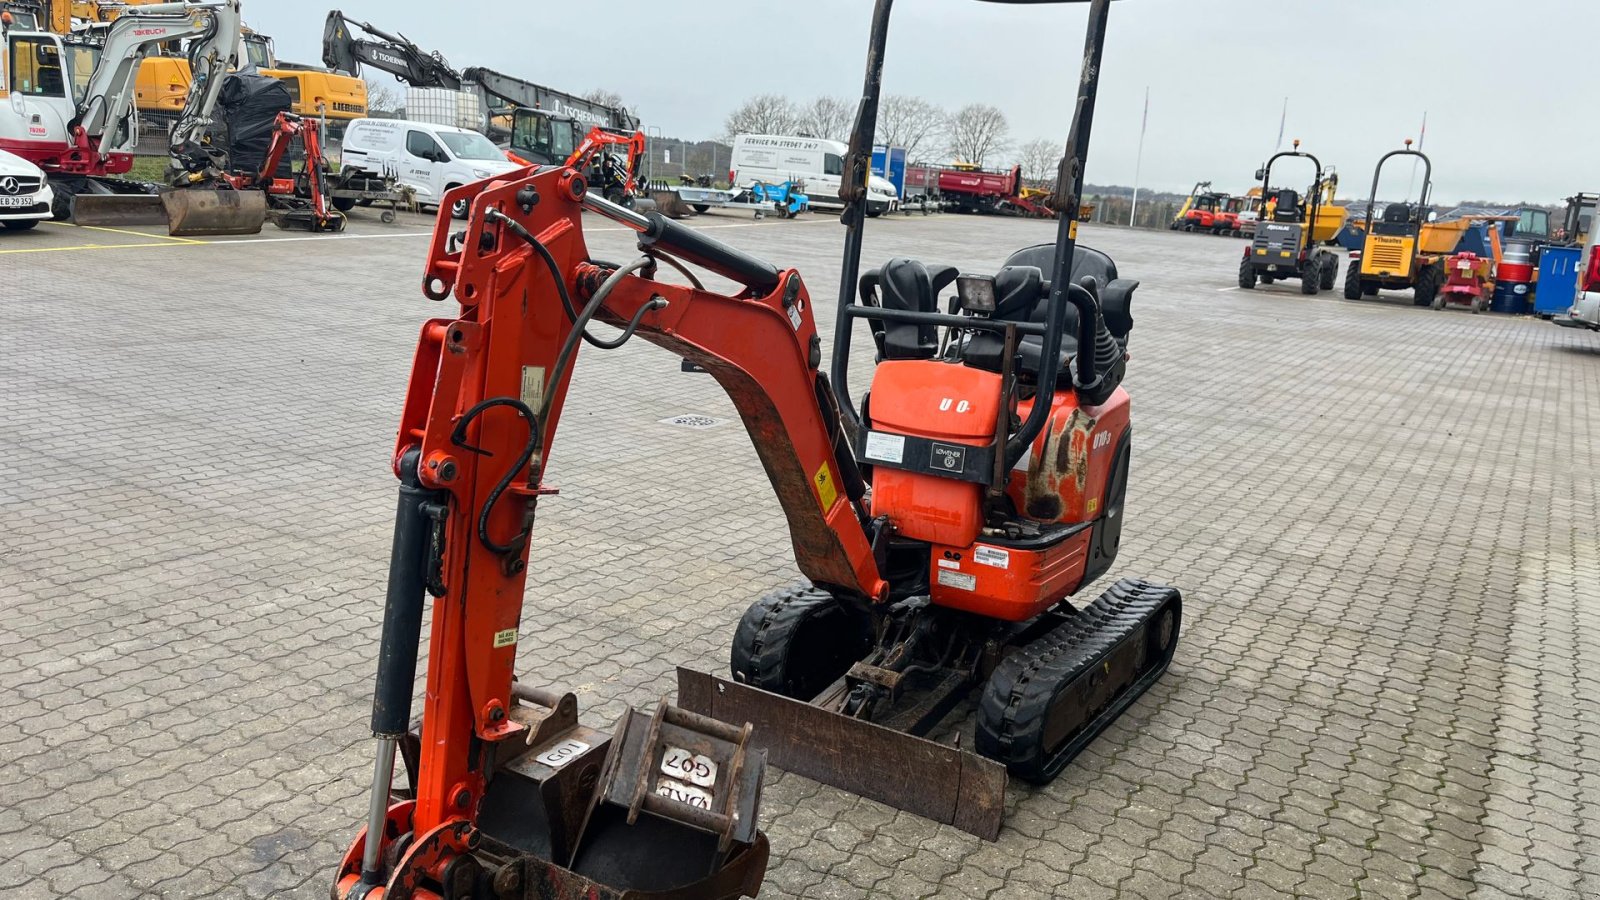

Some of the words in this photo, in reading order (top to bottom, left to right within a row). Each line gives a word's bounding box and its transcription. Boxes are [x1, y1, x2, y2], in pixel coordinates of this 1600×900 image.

[333, 102, 365, 113] LIEBHERR
[563, 105, 609, 128] TSCHERNING
[744, 137, 769, 146] SERVICE
[779, 140, 802, 149] STEDET
[11, 197, 20, 205] 29
[21, 197, 32, 205] 352
